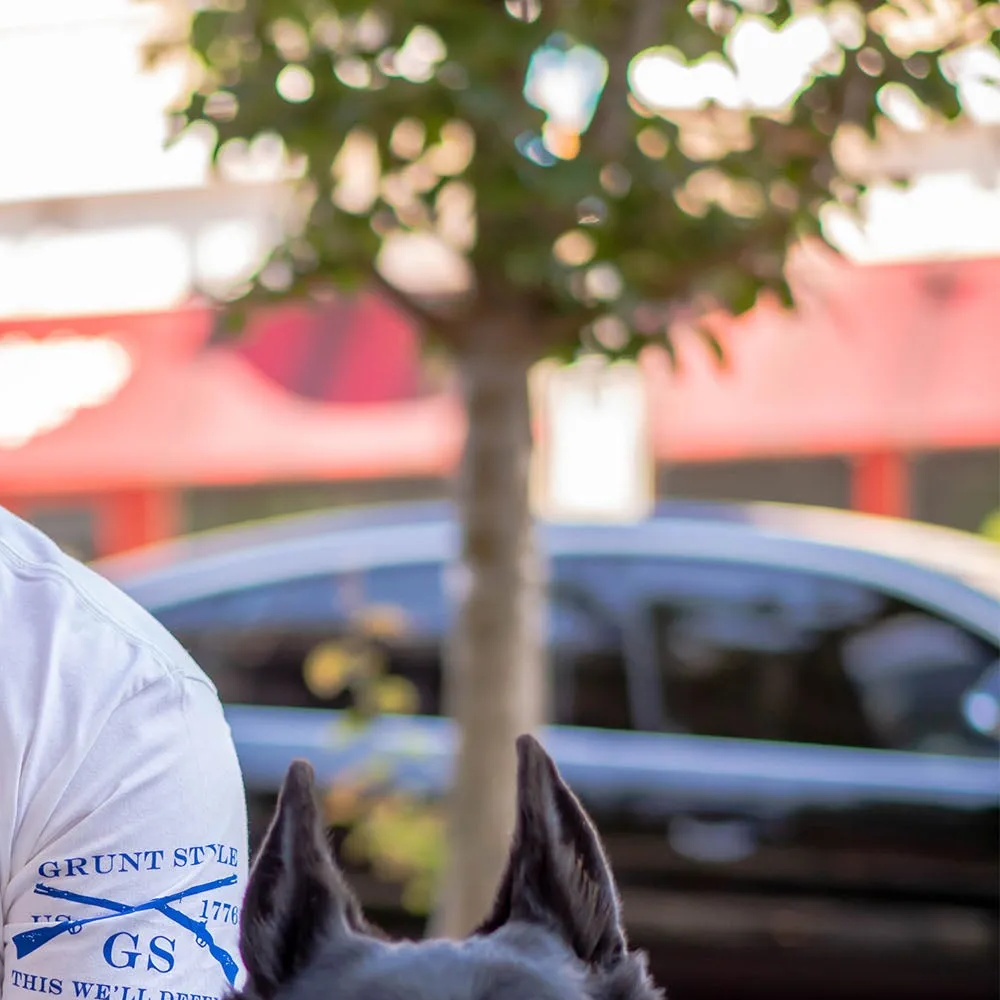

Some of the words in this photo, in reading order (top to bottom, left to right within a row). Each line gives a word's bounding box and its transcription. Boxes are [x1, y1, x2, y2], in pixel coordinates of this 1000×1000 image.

[38, 850, 164, 878] GRUNT
[199, 899, 238, 925] 1776
[102, 931, 176, 974] GS
[12, 969, 63, 996] THIS
